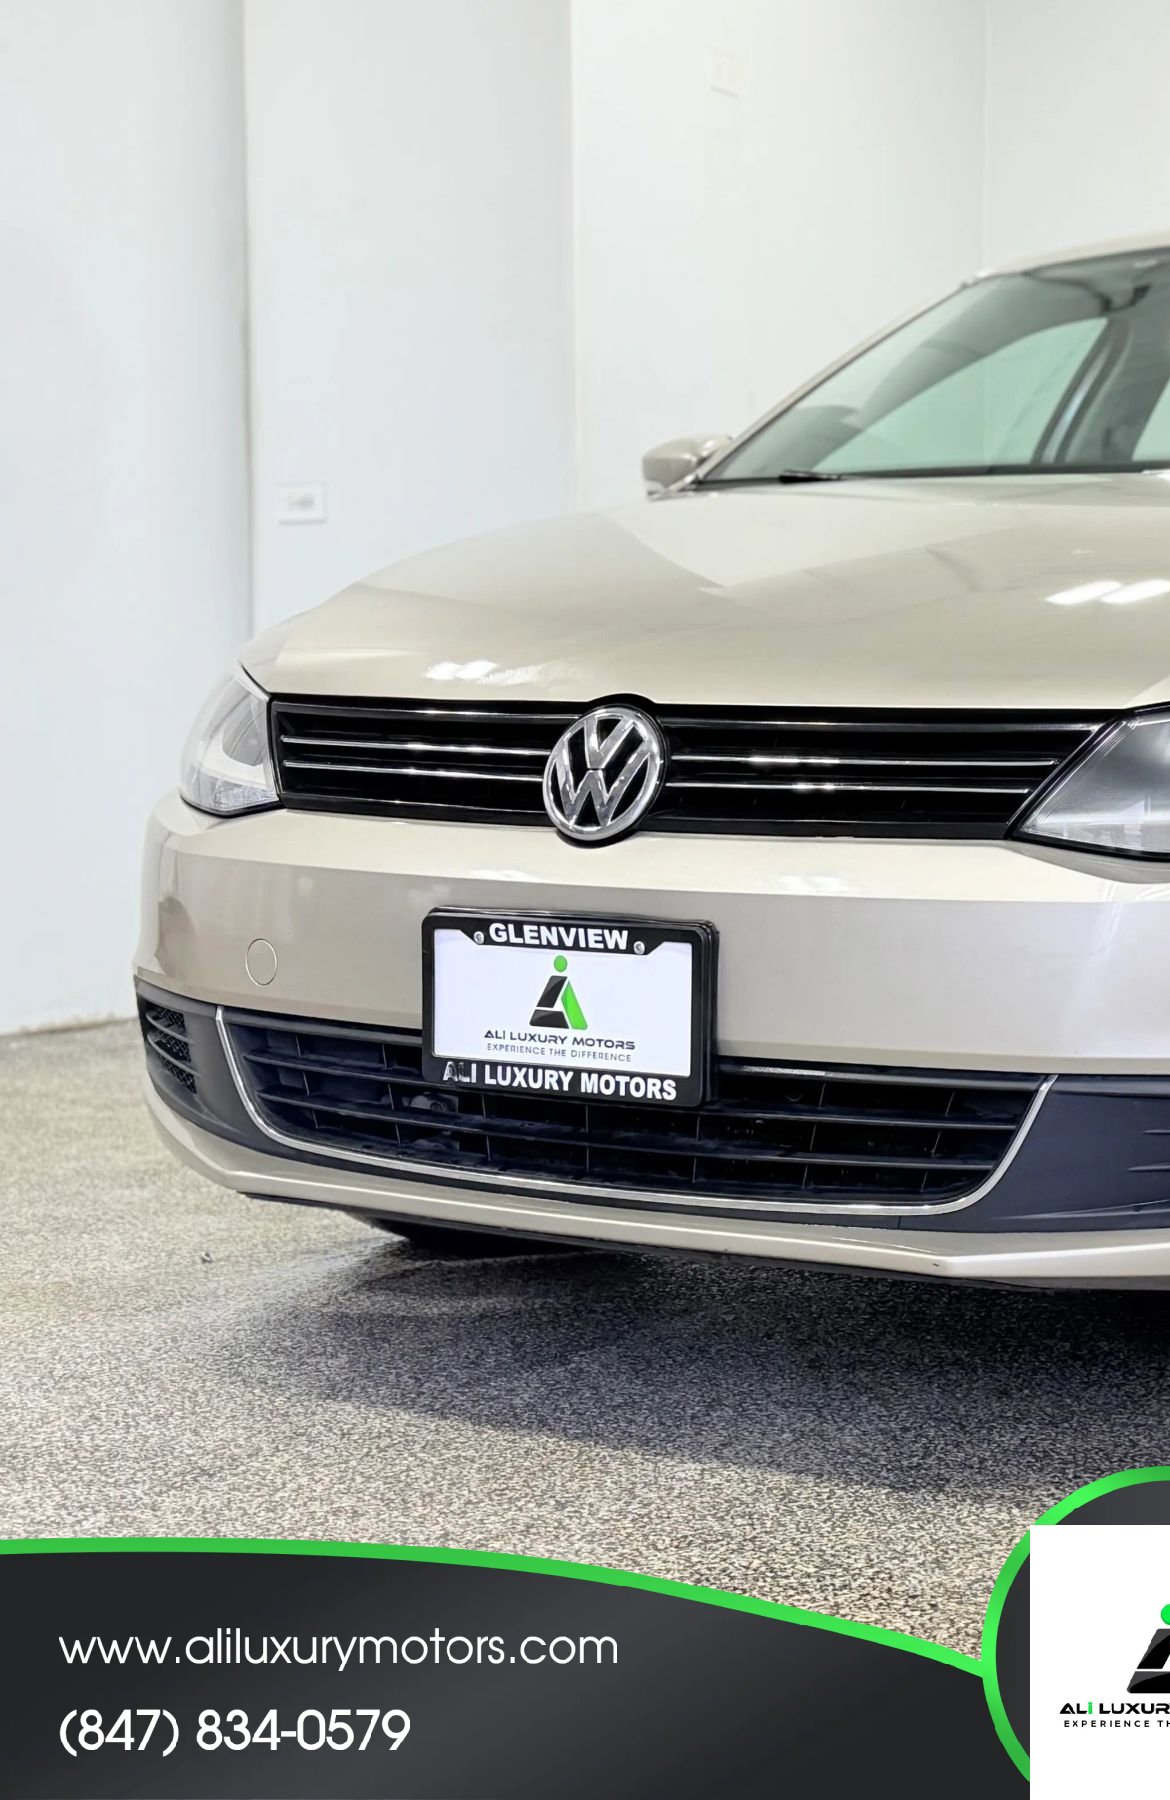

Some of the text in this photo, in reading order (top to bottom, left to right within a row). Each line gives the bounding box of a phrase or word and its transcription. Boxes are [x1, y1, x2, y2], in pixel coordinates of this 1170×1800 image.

[488, 922, 628, 951] GLENVIEW
[486, 1042, 633, 1063] EXPERIENCE THE DIFFERENCE
[509, 1030, 568, 1045] LUXURY
[572, 1036, 636, 1051] MOTORS
[442, 1061, 678, 1101] ALI LUXURY MOTORS
